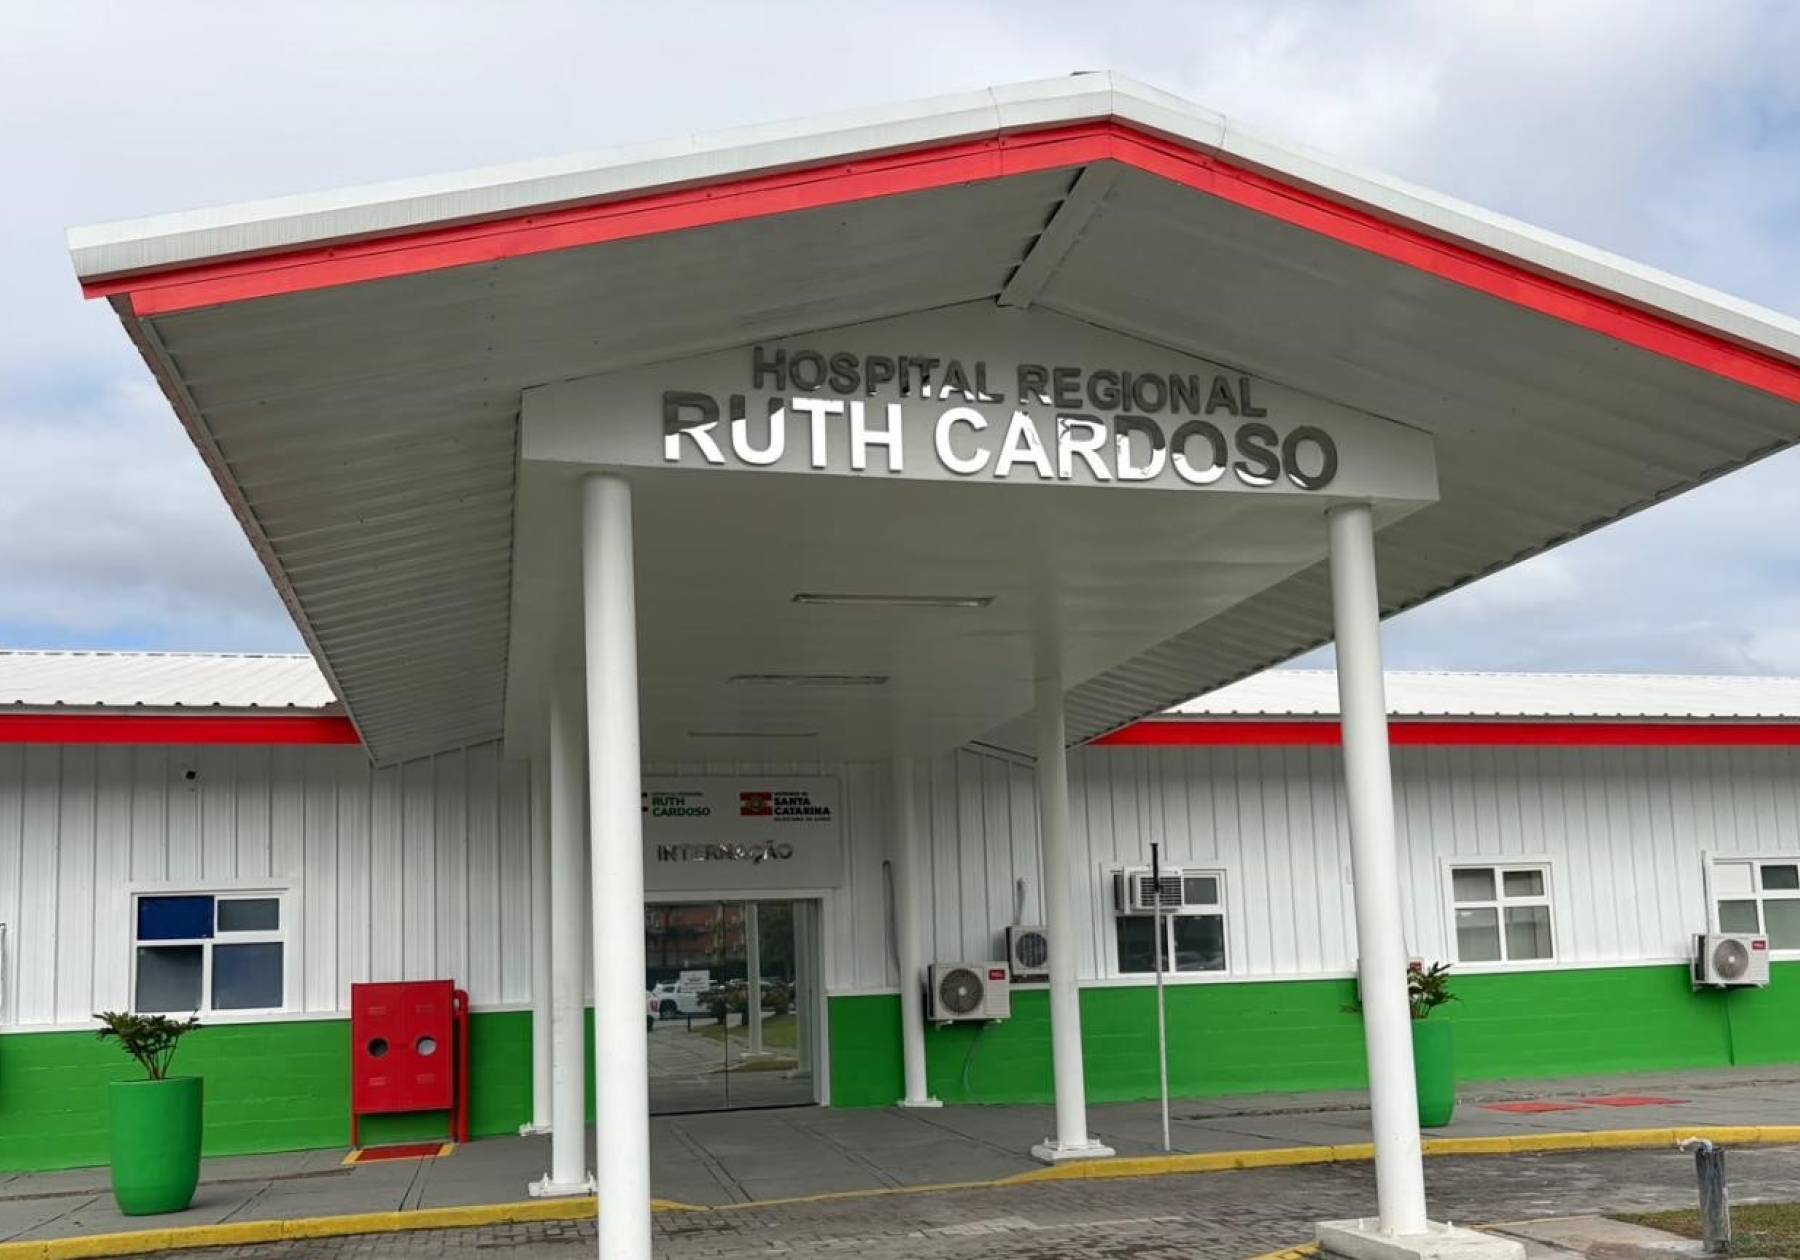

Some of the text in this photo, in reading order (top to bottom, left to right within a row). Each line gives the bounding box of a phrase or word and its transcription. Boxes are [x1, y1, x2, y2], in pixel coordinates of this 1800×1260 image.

[752, 346, 1268, 417] HOSPITAL REGIONAL
[663, 390, 1338, 490] RUTH CARDOSO
[652, 796, 685, 806] RUTH
[774, 797, 811, 806] SANTA
[652, 807, 711, 816] CARDOSO
